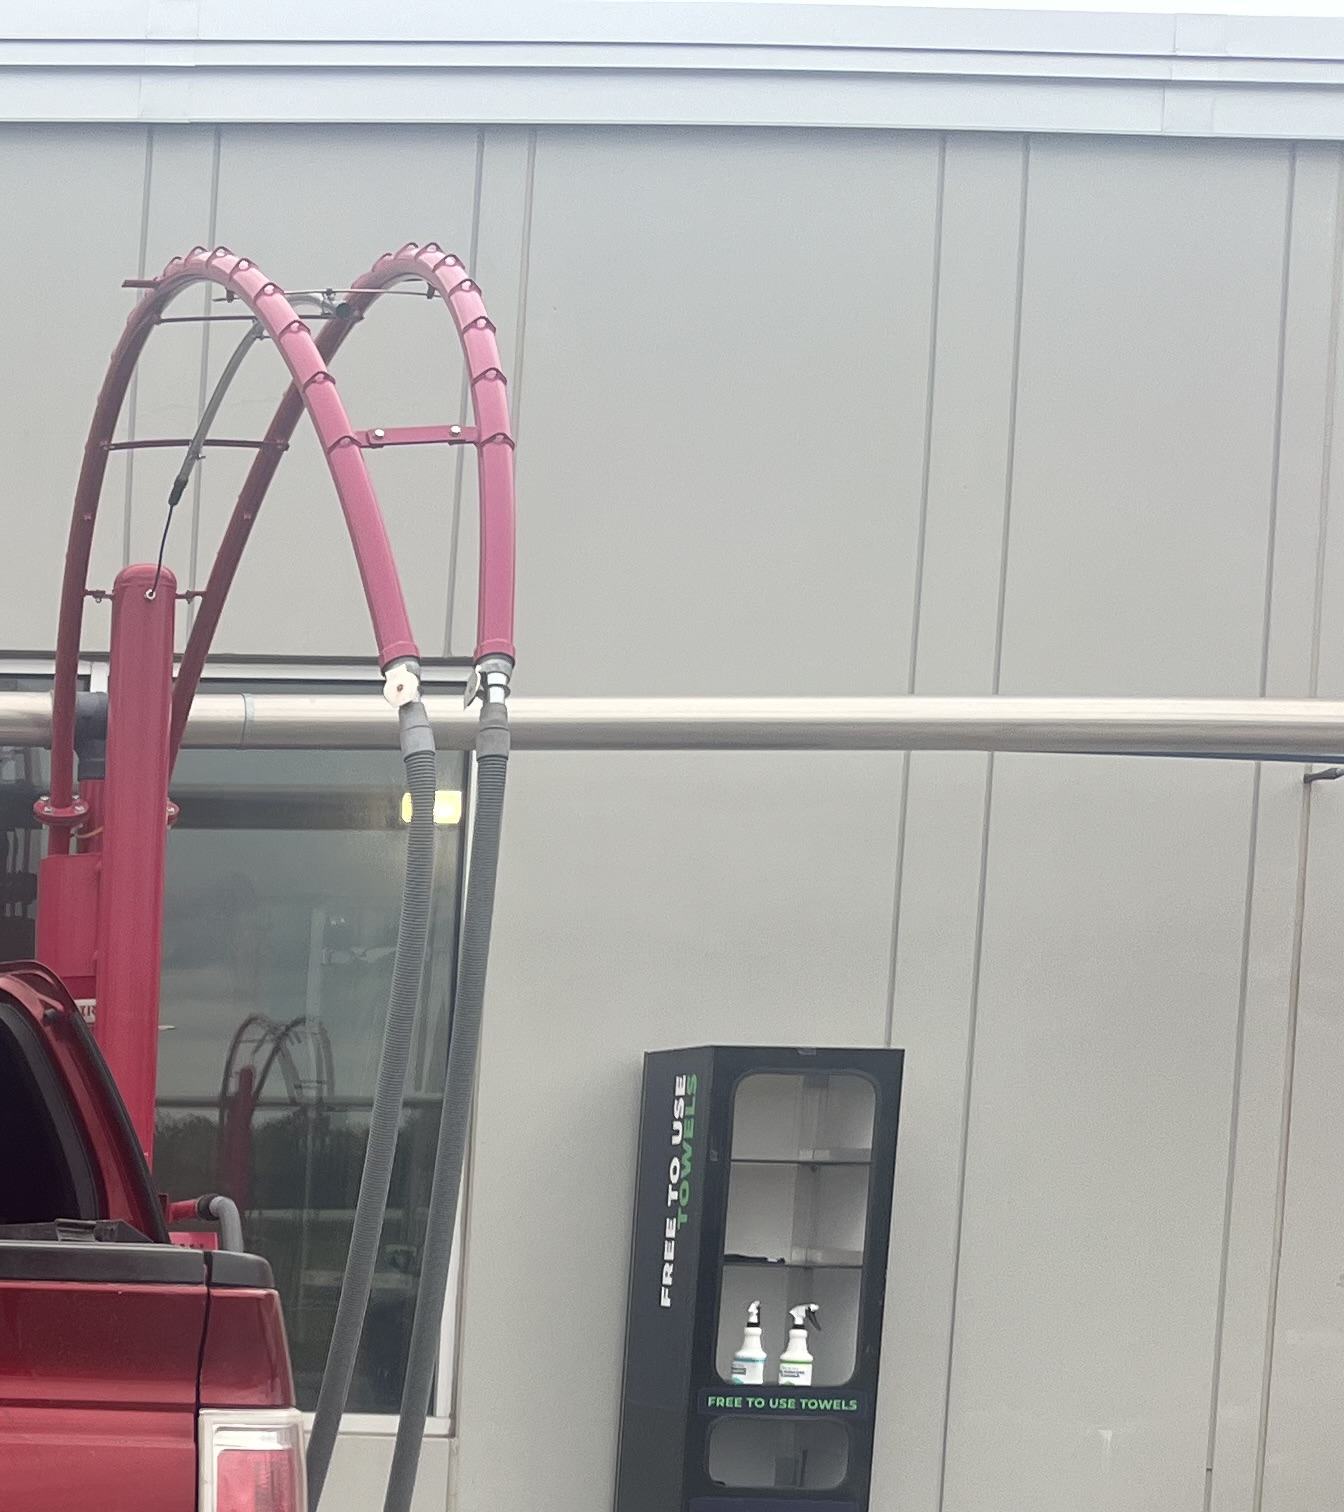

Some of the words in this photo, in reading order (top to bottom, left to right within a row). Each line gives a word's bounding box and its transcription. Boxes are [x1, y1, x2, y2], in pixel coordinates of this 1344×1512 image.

[671, 1074, 687, 1145] USE
[667, 1157, 681, 1207] TO
[677, 1074, 698, 1231] TOWELS
[660, 1217, 677, 1308] FREE
[708, 1396, 742, 1408] FREE
[746, 1397, 765, 1409] TO
[769, 1398, 796, 1410] USE
[800, 1399, 857, 1411] TOWELS
